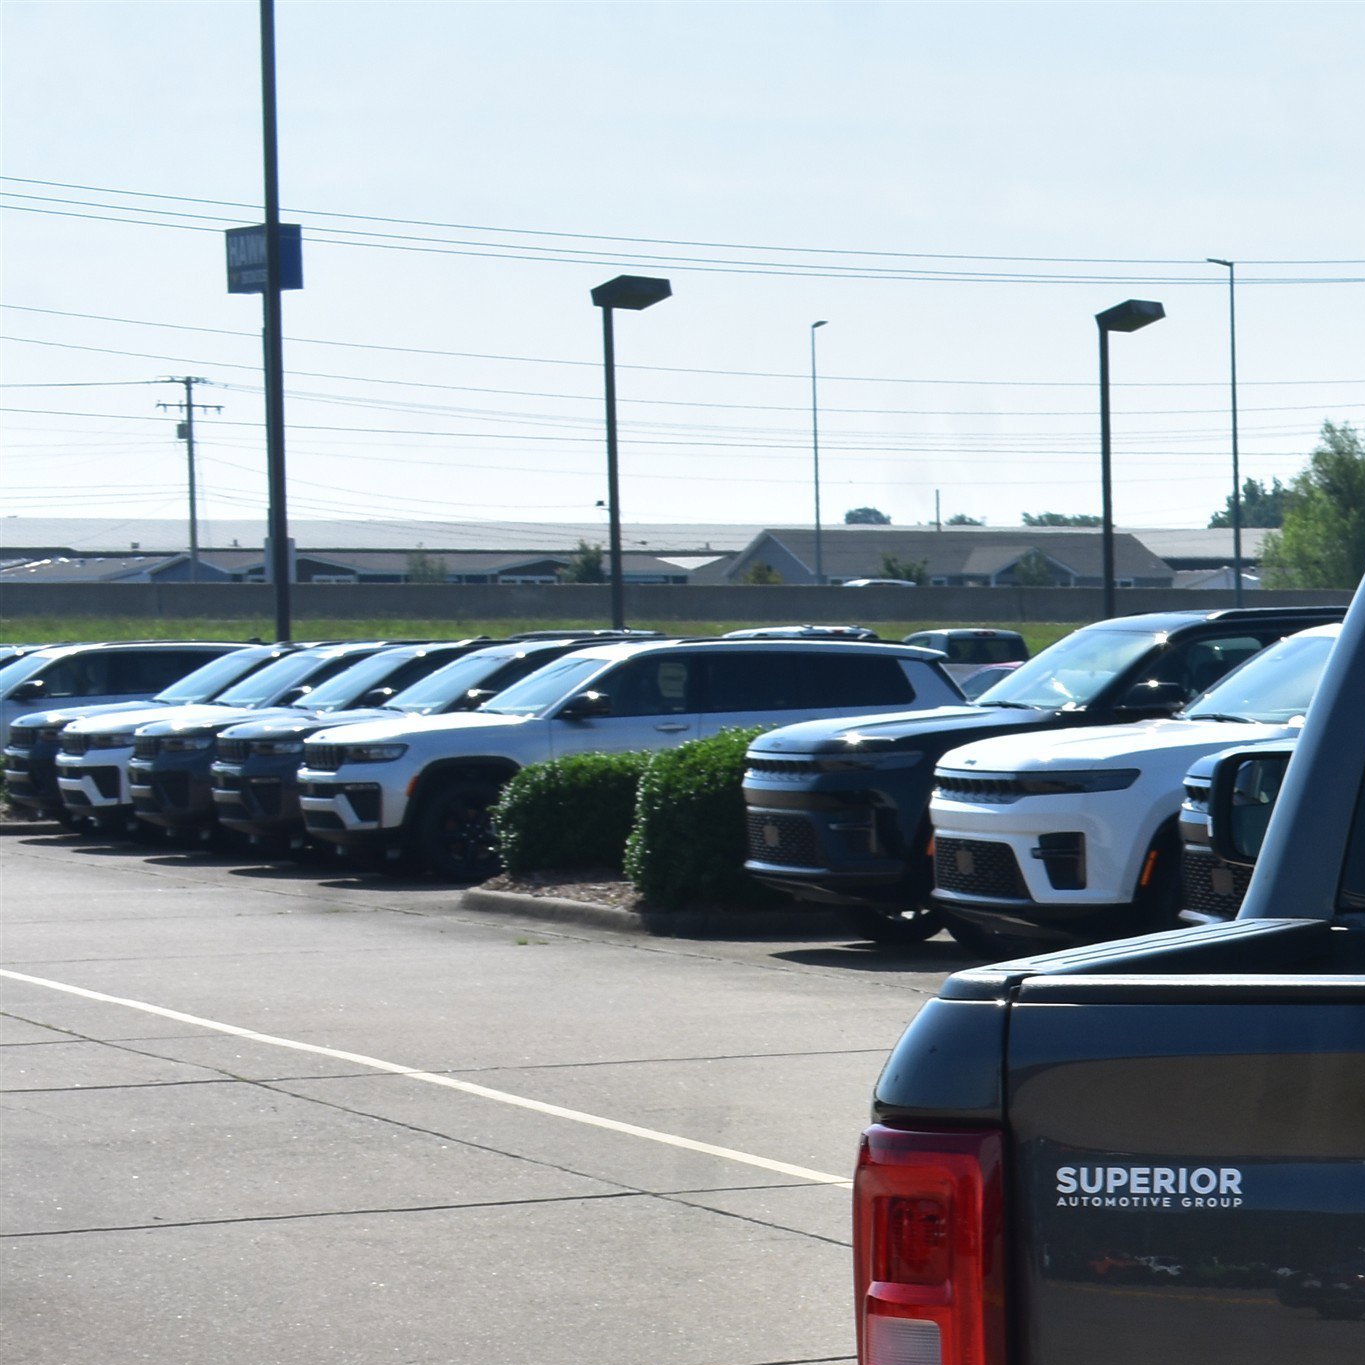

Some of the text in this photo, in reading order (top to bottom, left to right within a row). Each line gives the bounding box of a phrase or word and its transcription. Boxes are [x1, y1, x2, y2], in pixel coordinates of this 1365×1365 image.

[1055, 1166, 1244, 1195] SUPERIOR
[1056, 1196, 1244, 1208] AUTOMOTIVE GROUP
